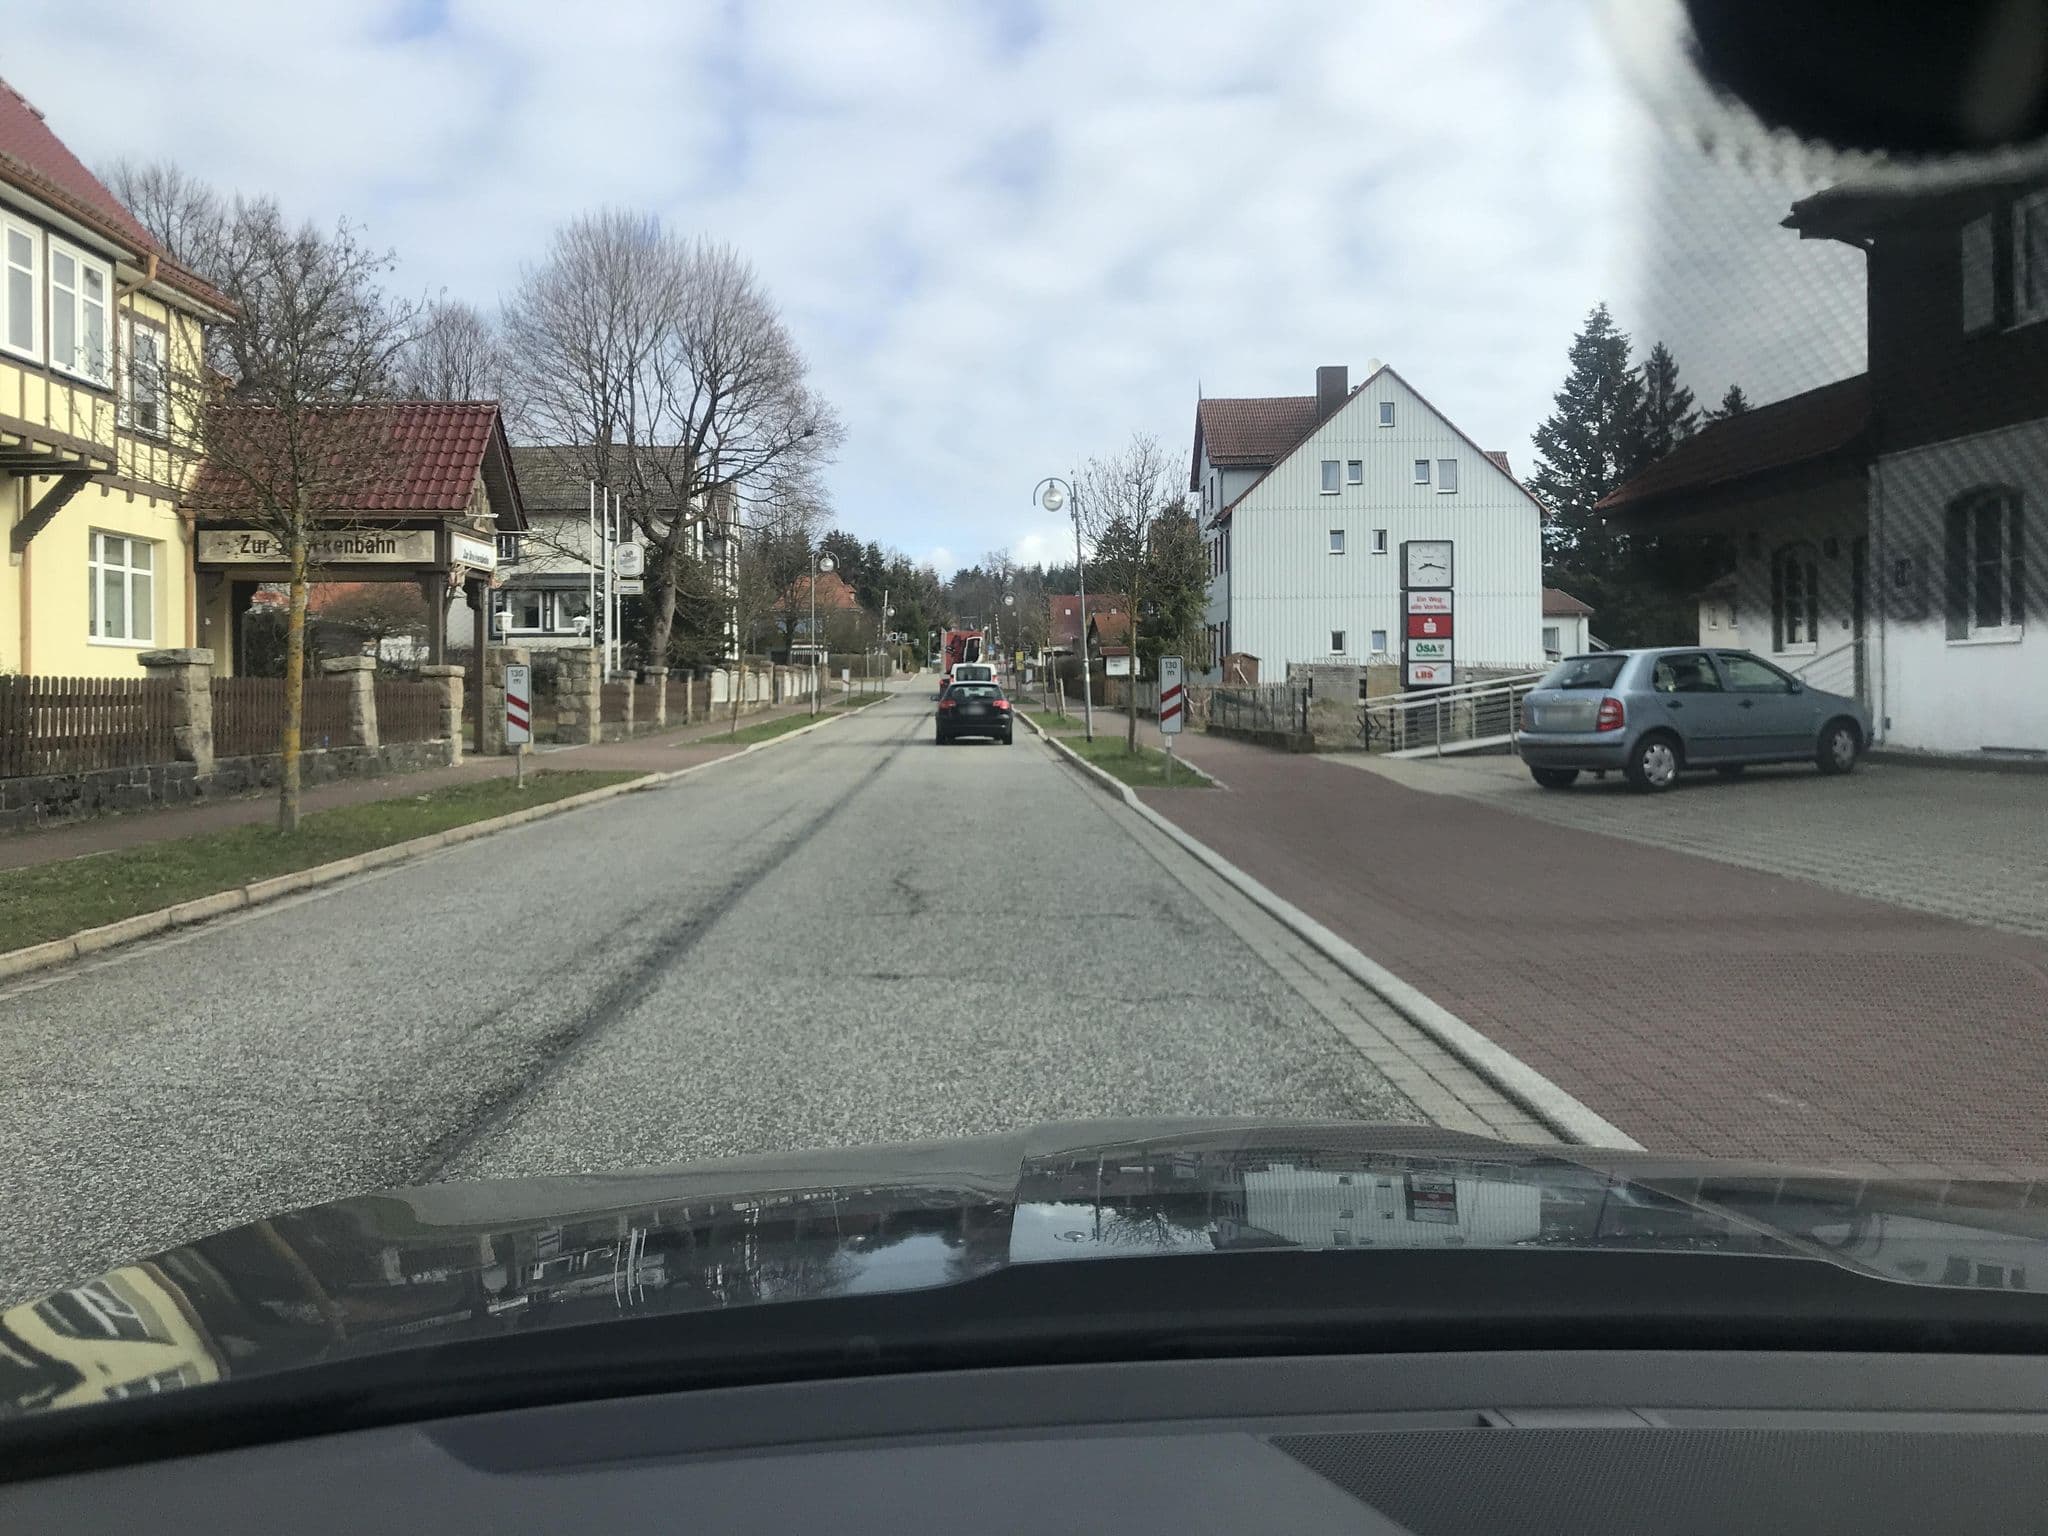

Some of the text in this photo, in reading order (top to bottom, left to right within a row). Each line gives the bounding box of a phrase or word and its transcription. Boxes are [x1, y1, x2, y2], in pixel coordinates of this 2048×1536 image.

[240, 534, 269, 554] Zur
[1416, 642, 1437, 653] ÖSA
[1415, 670, 1433, 679] LBS
